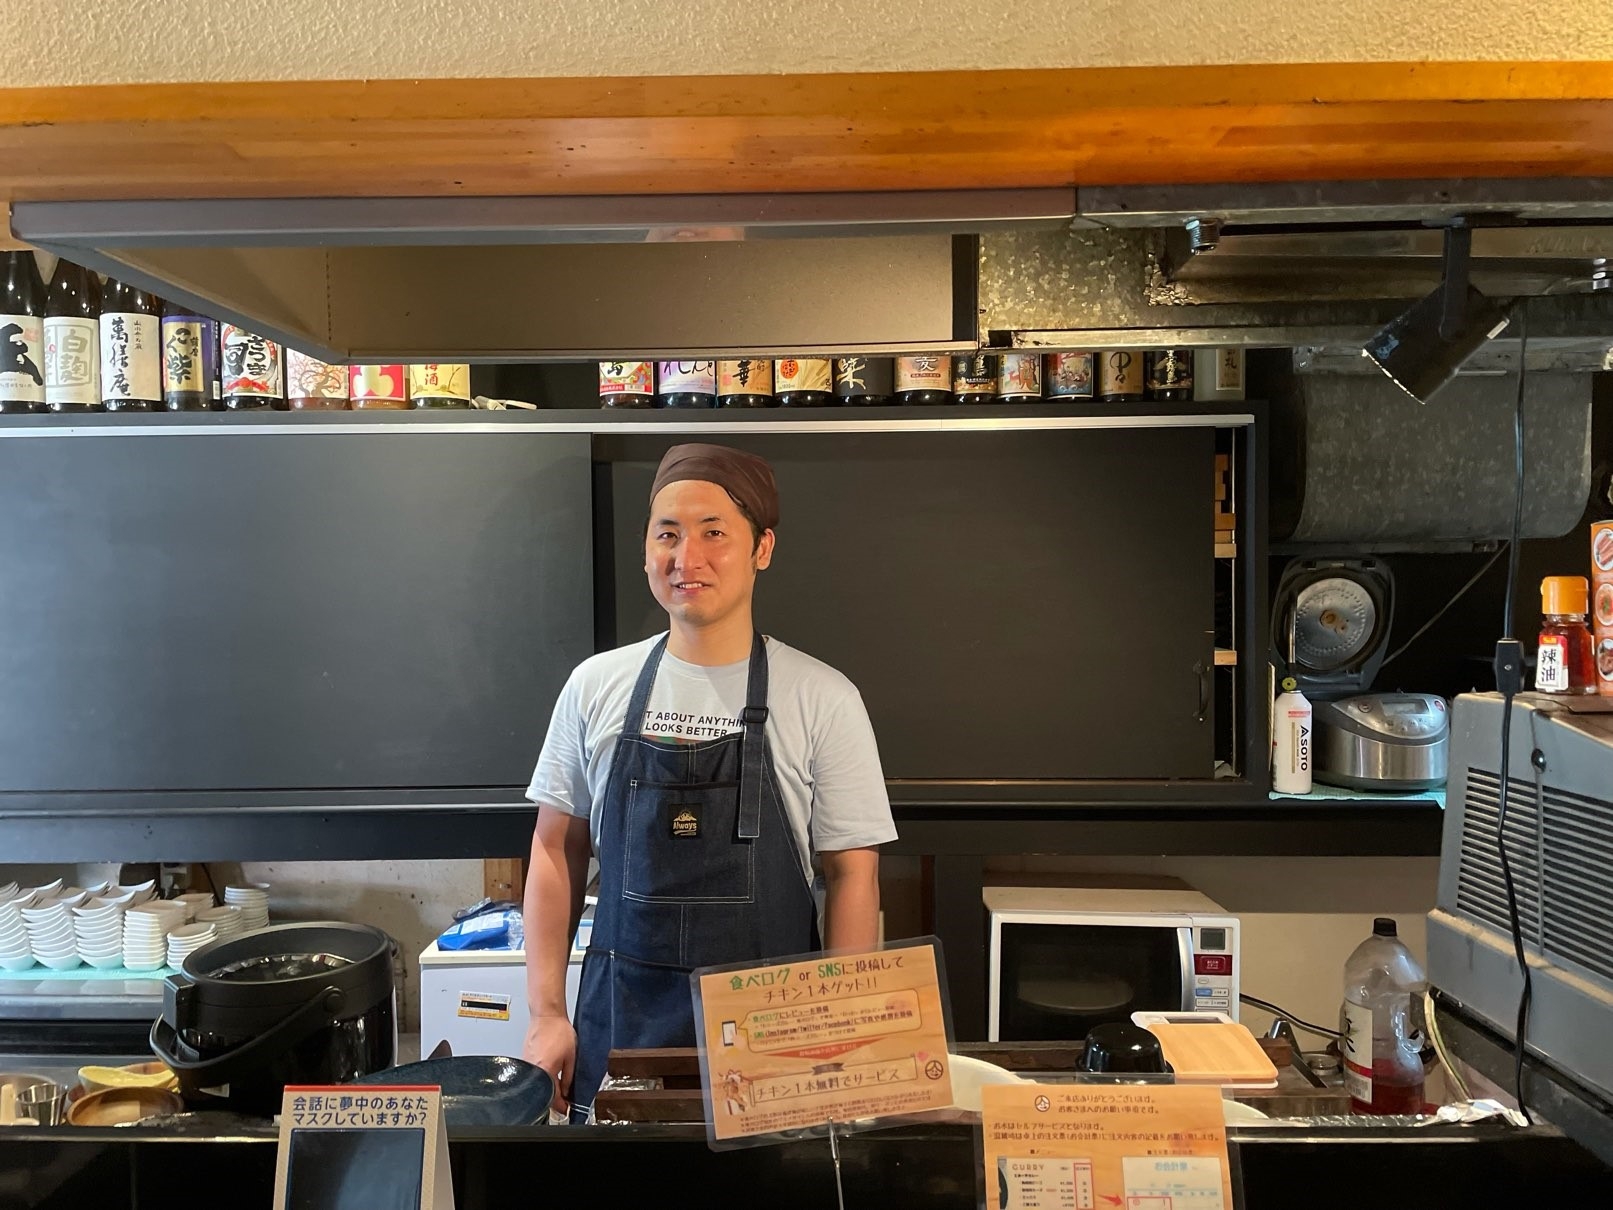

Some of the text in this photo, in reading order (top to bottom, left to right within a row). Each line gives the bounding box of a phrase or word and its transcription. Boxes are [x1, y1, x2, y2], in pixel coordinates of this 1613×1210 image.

[656, 711, 695, 723] ABOUT
[698, 716, 746, 727] ANYTHIN
[645, 723, 727, 737] LOOKS BETTER
[673, 821, 697, 830] Always
[799, 970, 811, 981] or
[293, 1096, 428, 1112] 会話に夢中のあなた
[293, 1112, 427, 1126] マスクしていますか?
